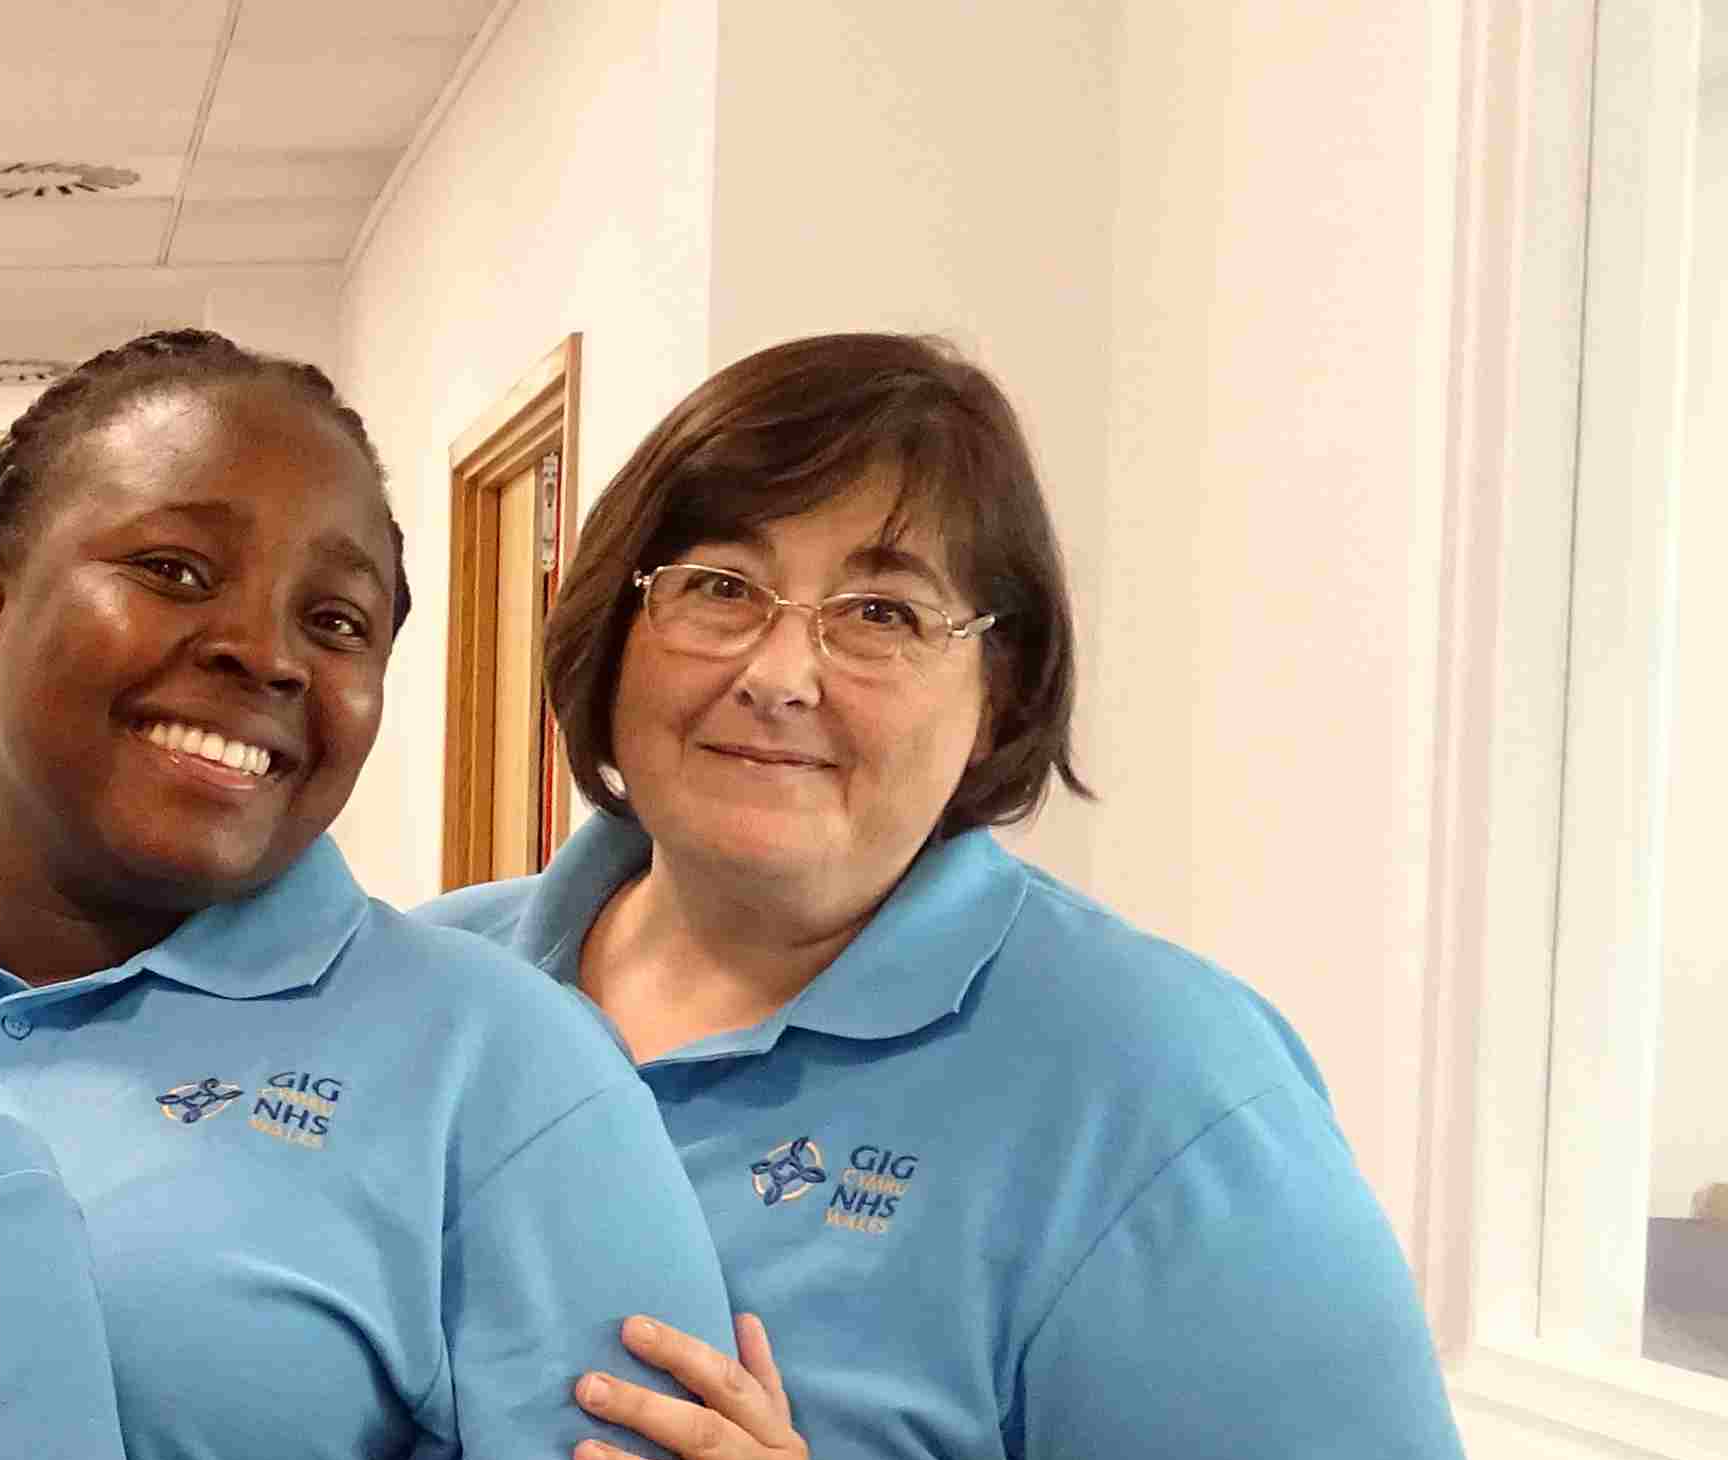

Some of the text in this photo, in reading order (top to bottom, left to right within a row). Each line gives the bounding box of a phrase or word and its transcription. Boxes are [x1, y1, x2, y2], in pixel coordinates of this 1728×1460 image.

[268, 1072, 342, 1101] GIG
[253, 1098, 329, 1134] NHS
[850, 1145, 919, 1179] GIG
[830, 1184, 899, 1217] NHS
